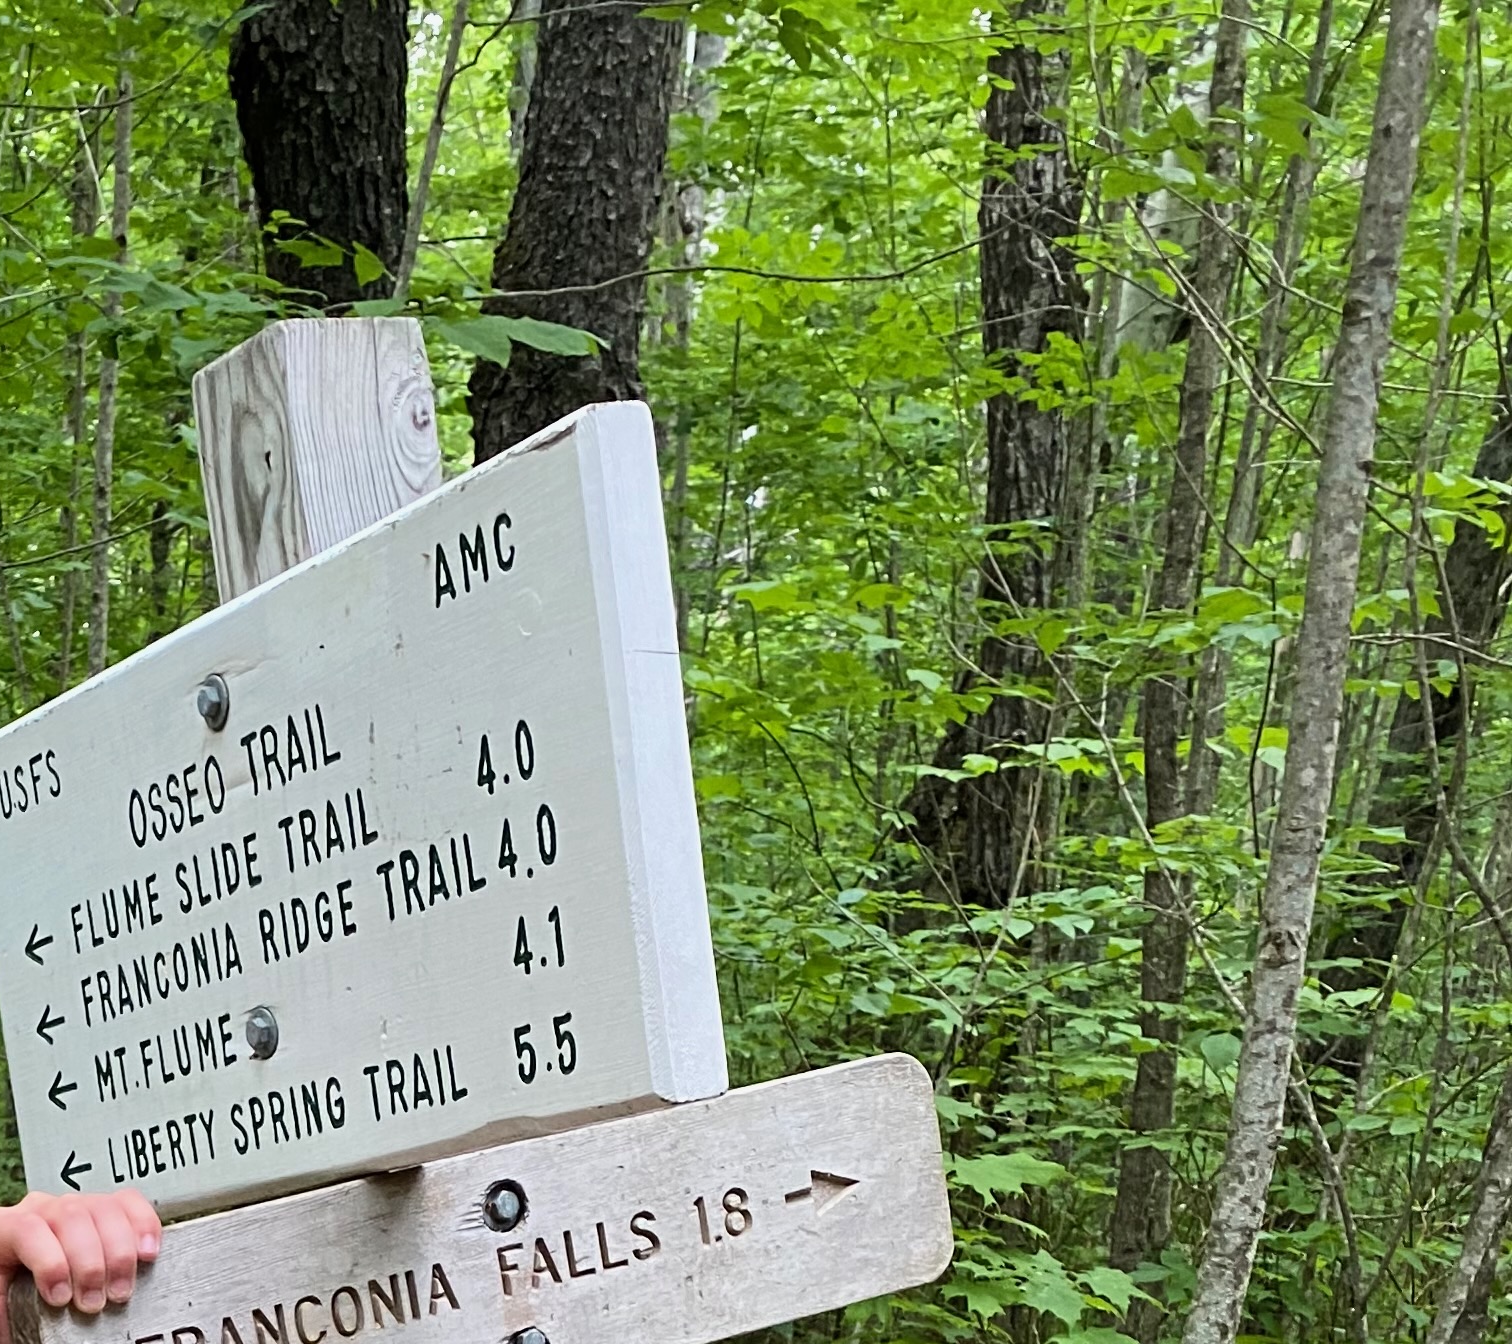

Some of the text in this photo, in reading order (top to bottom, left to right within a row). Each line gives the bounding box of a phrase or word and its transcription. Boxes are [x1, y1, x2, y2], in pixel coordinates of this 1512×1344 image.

[435, 512, 515, 609] AMC
[70, 719, 535, 954] FLUME SLIDE TRAIL 4.0
[128, 703, 342, 848] OSSEO TRAIL
[80, 803, 557, 1028] FRANCONIA RIDGE TRAIL 4.0
[513, 905, 565, 975] 4.1
[108, 1011, 577, 1184] LIBERTY SPRING TRAIL 5.5
[497, 1211, 661, 1296] FALLS
[693, 1187, 754, 1246] 1.8
